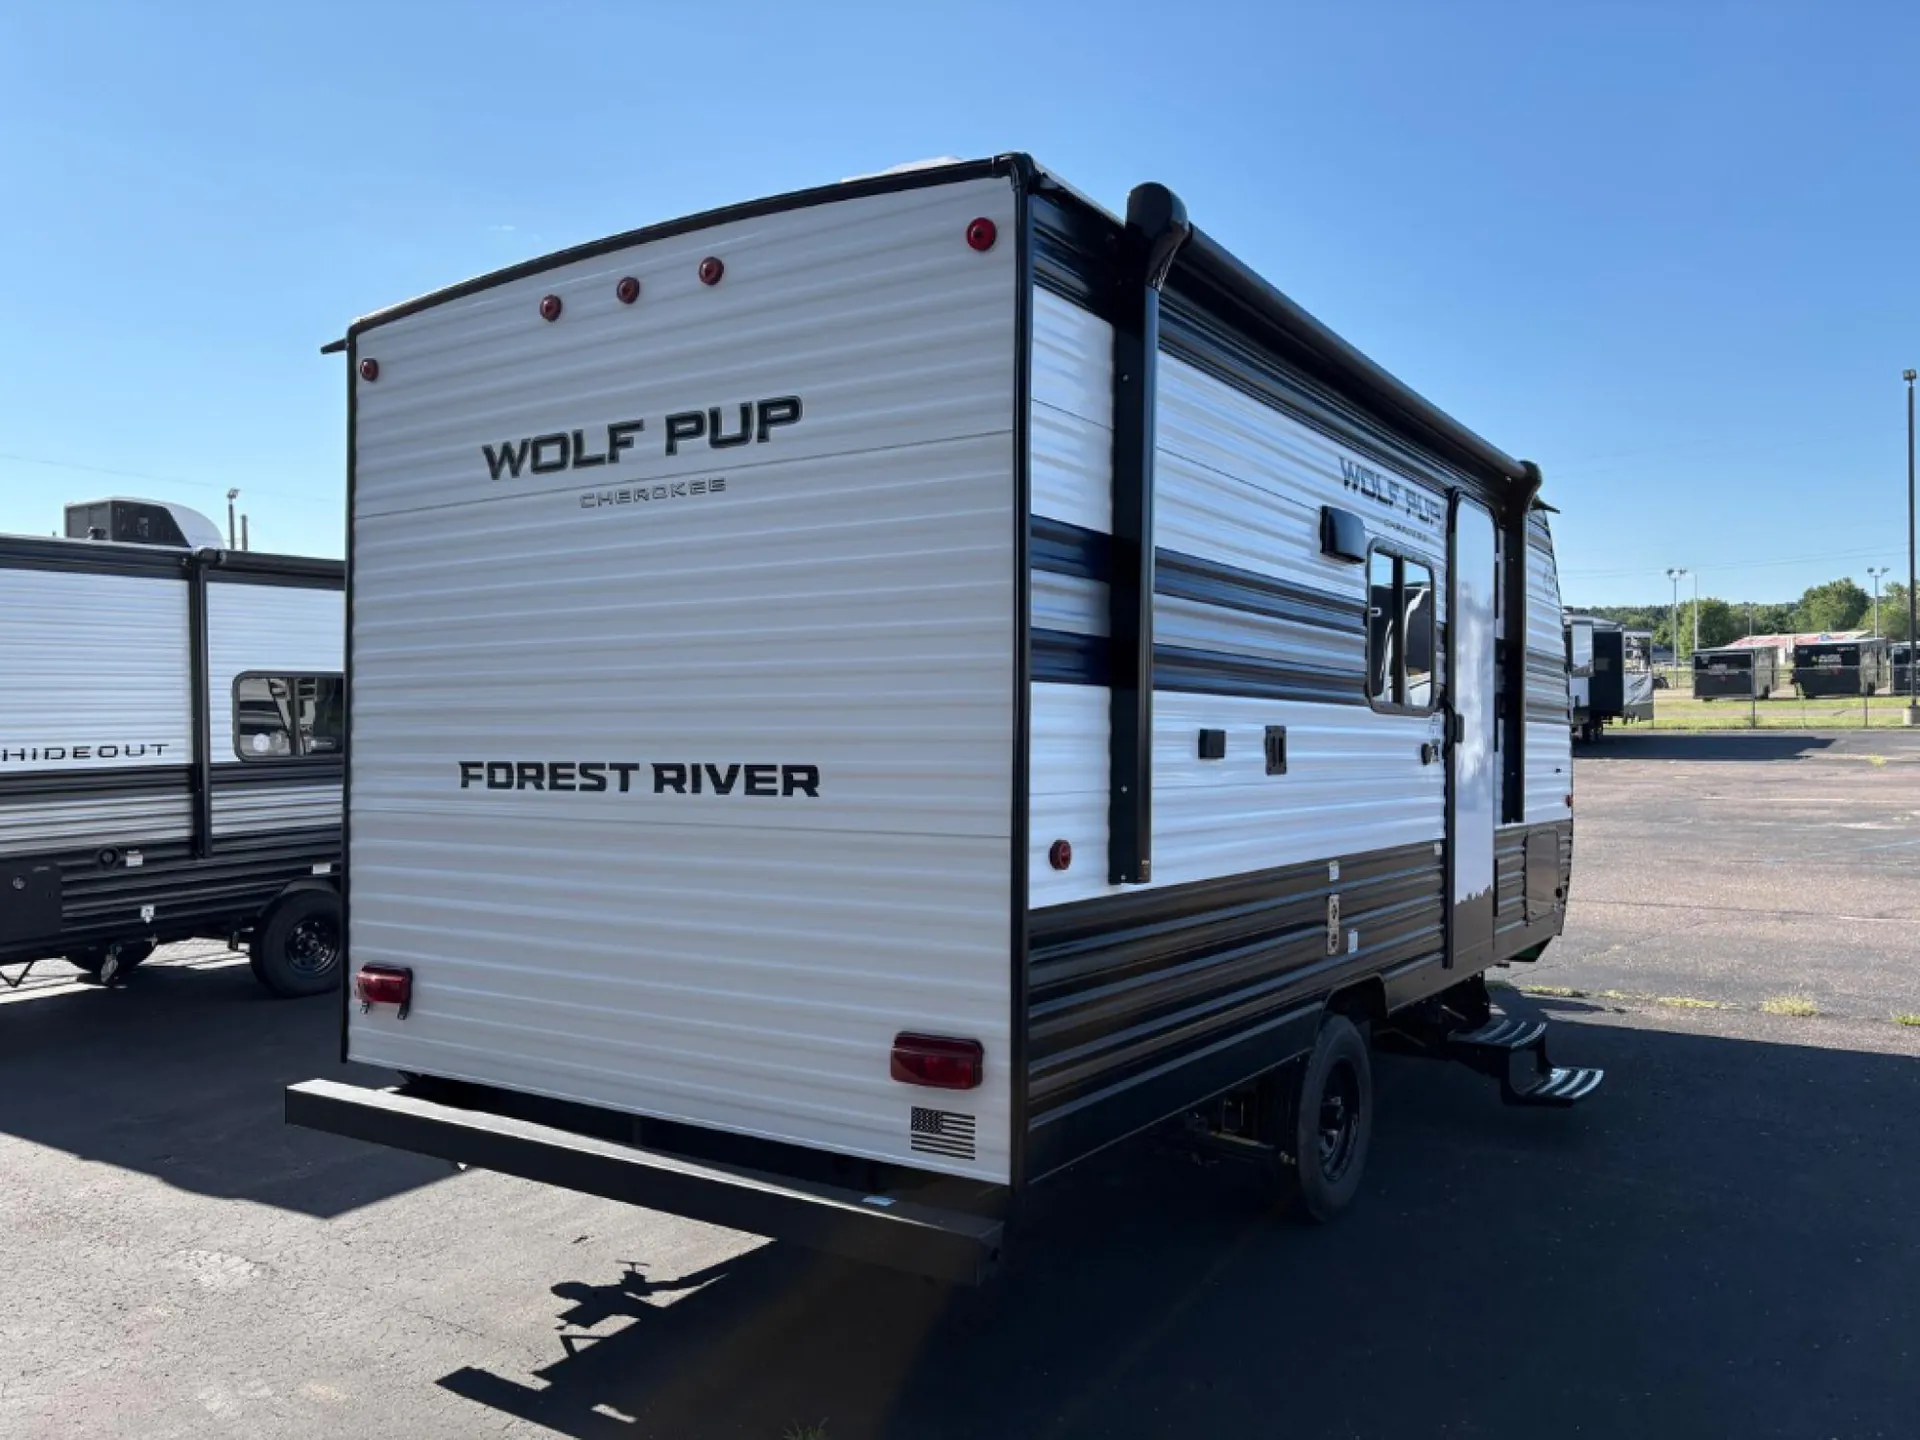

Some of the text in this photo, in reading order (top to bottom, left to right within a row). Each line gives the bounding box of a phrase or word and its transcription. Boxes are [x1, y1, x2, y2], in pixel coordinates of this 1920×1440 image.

[482, 395, 803, 481] WOLF PUP
[579, 478, 726, 509] CHEROKEE
[1339, 456, 1399, 508] WOLF
[1, 743, 169, 762] HIDEOUT
[458, 760, 820, 798] FOREST RIVER
